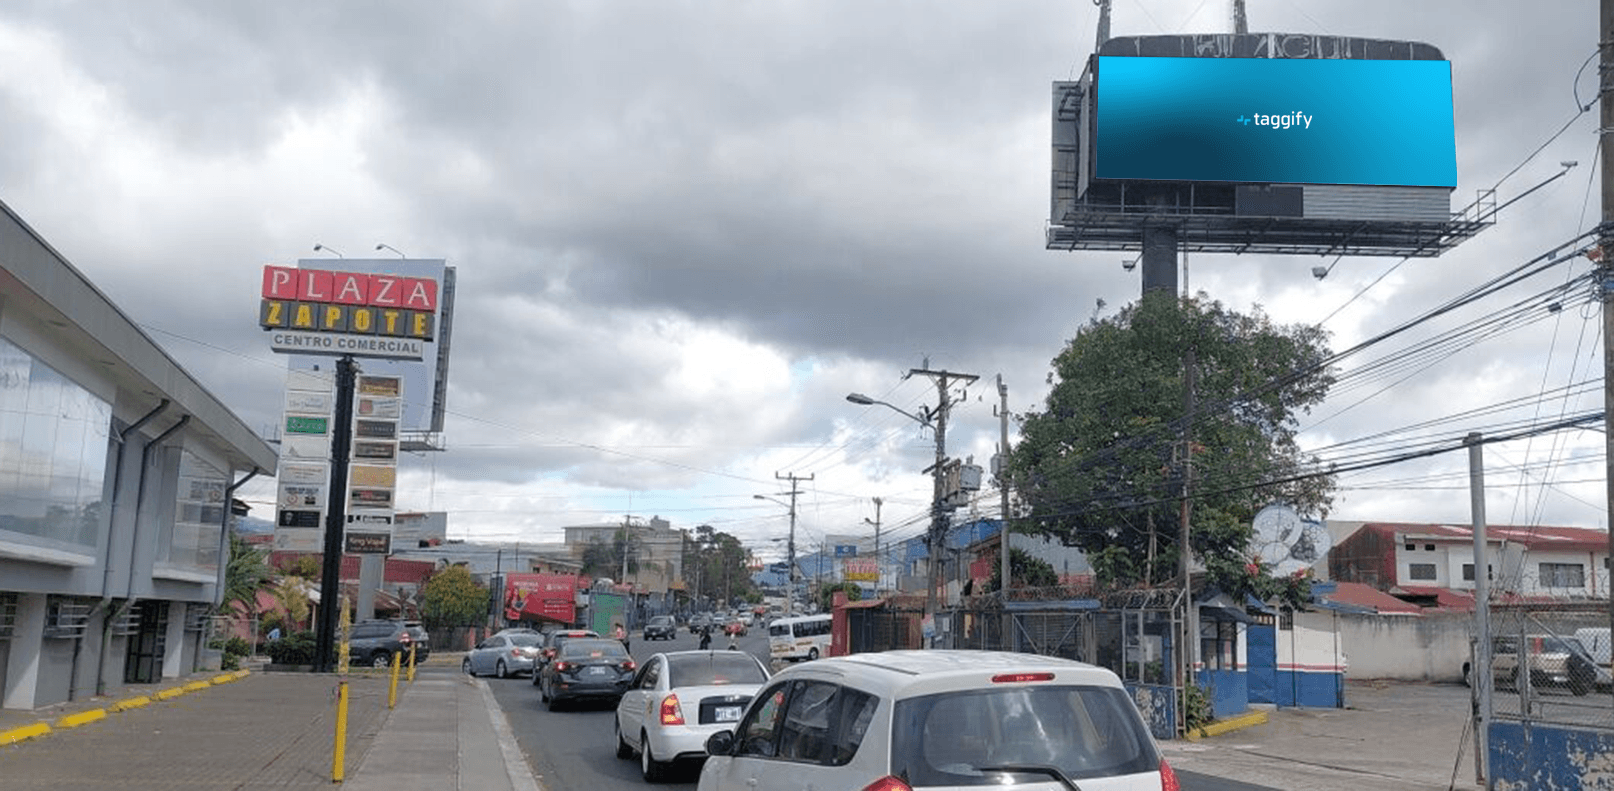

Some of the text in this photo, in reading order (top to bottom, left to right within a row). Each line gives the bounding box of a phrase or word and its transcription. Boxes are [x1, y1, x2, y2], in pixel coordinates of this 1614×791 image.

[1253, 110, 1313, 130] taggify
[271, 270, 430, 307] PLAZA
[267, 302, 427, 336] ZAPOTE
[274, 334, 419, 354] CENTRO COMERCIAL
